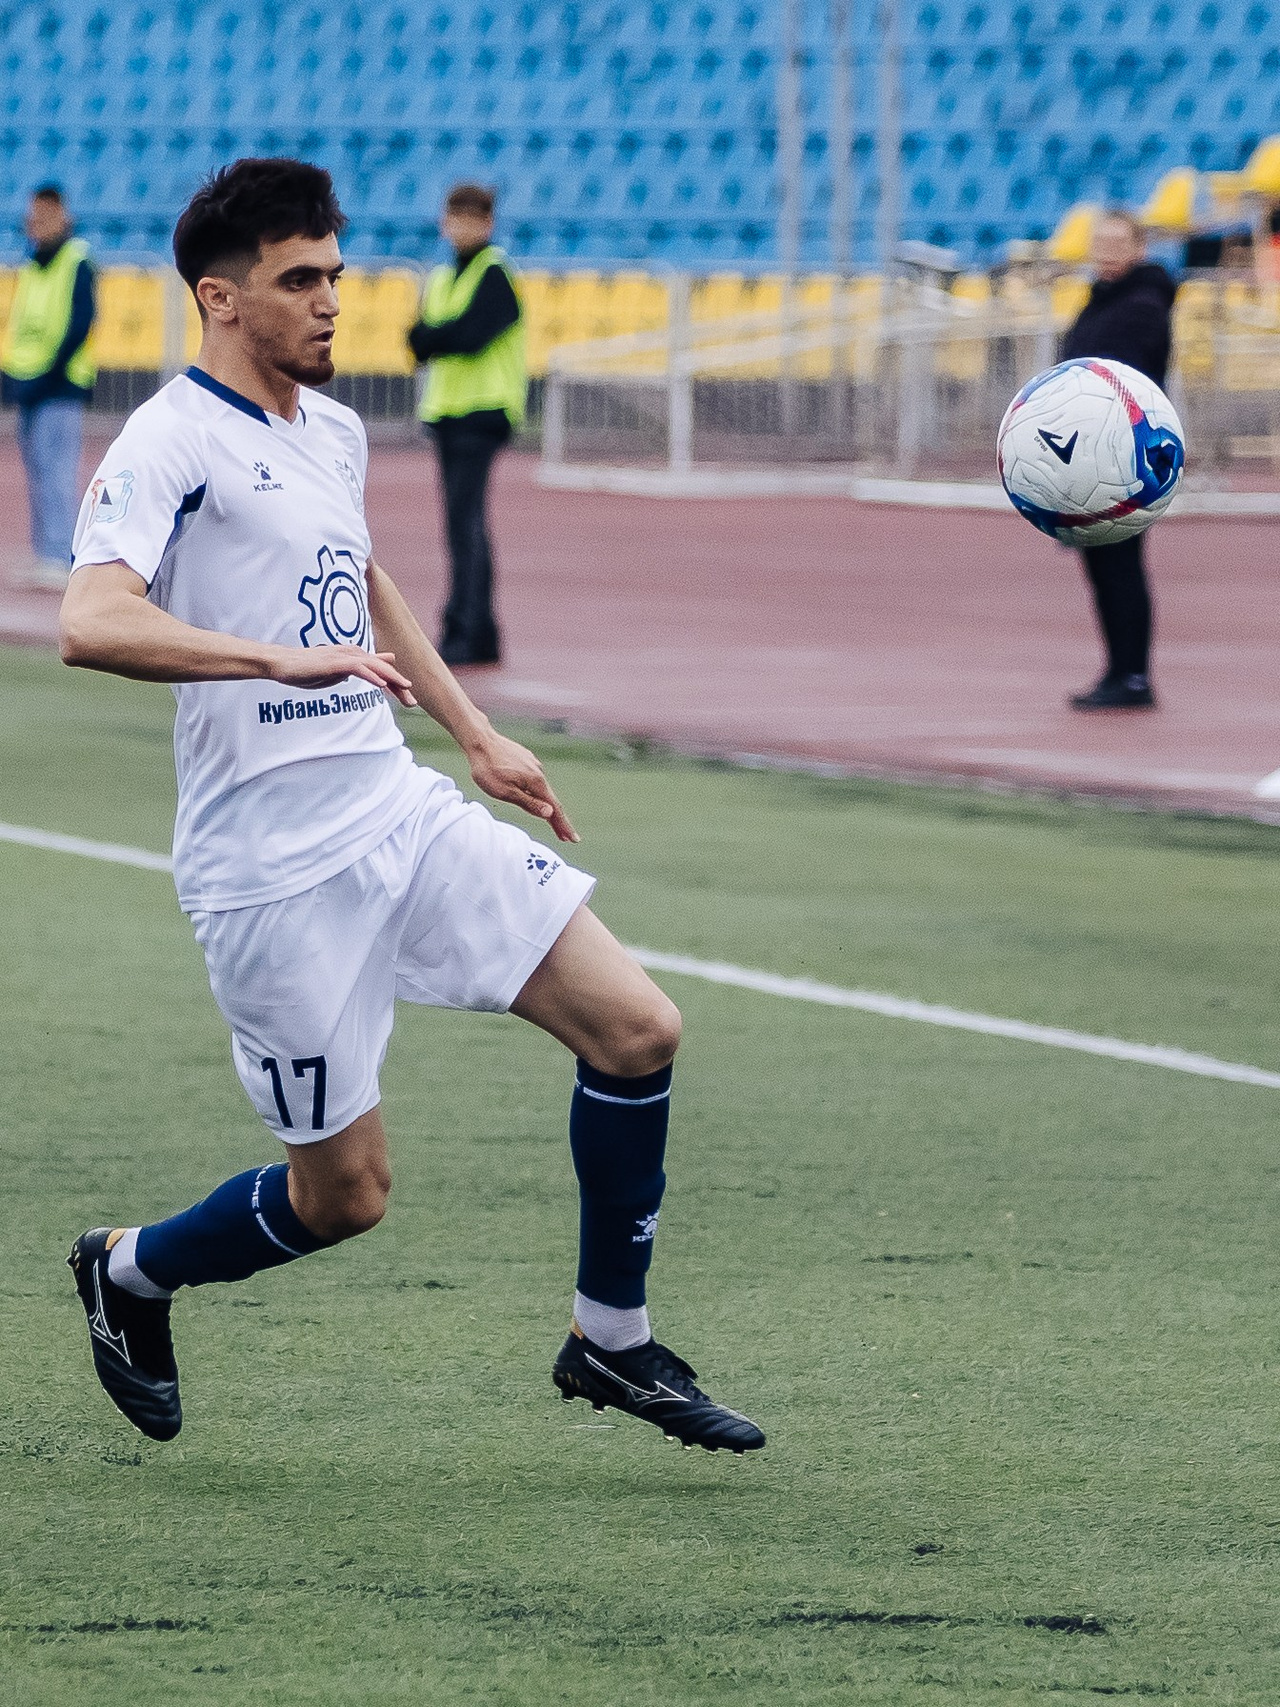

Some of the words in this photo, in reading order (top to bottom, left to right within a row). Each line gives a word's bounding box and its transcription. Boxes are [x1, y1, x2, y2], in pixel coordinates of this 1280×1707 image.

[253, 483, 285, 492] KELME
[538, 860, 561, 886] KELME
[260, 1054, 328, 1130] 17
